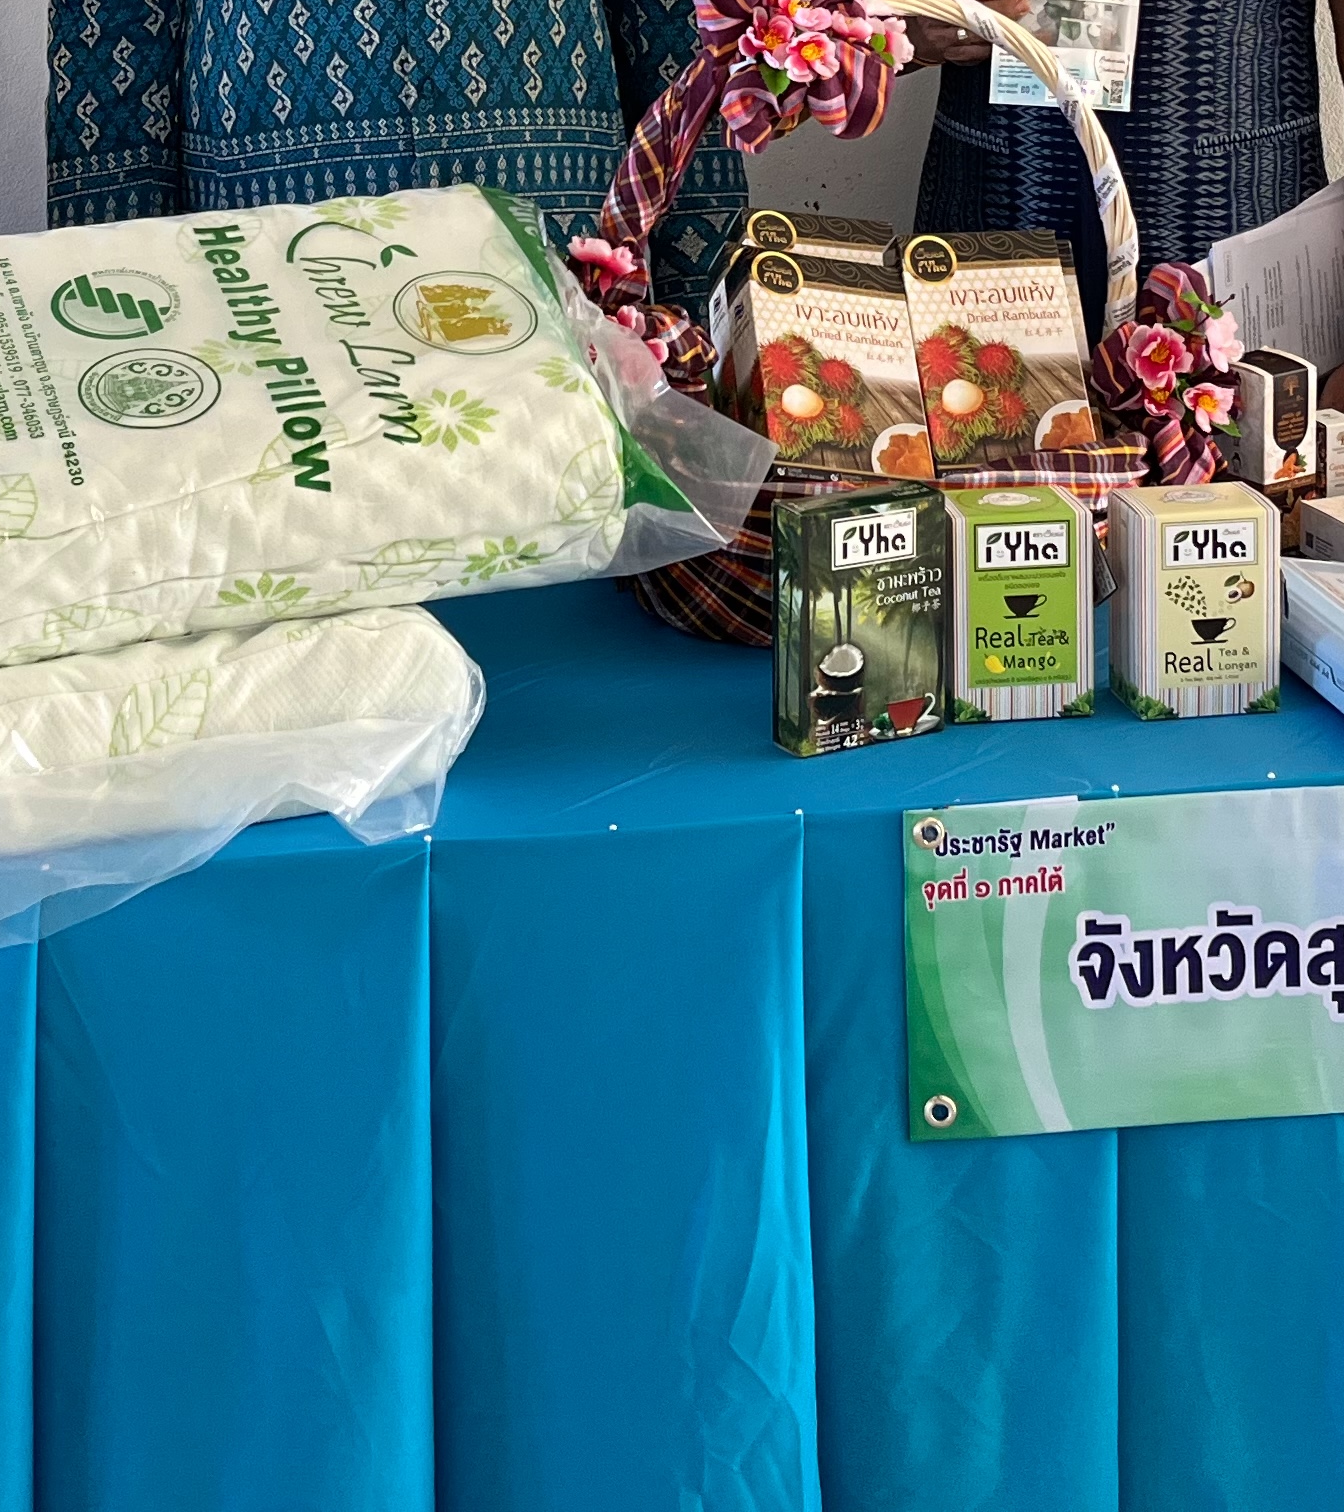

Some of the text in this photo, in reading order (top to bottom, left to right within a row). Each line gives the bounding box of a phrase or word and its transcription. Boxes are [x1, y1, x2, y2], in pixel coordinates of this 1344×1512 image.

[950, 280, 1056, 306] เงาะอบแห้ง
[795, 303, 899, 332] เงาะอบแห้ง
[967, 308, 1061, 324] Dried Rambutan
[811, 328, 904, 349] Dried Rambutan
[193, 225, 332, 492] Healthy Pillow
[339, 339, 422, 445] Larn
[61, 441, 85, 486] 84230
[876, 566, 942, 591] ชามะพร้าว
[876, 585, 942, 606] Coconut Tea
[975, 623, 1069, 649] Real Tea &
[1003, 654, 1056, 671] Mango
[1164, 647, 1250, 674] Real Tea &
[1218, 661, 1258, 672] Longan
[843, 734, 858, 748] 42
[923, 867, 967, 910] จุดที่
[998, 865, 1064, 897] ภาคใต้
